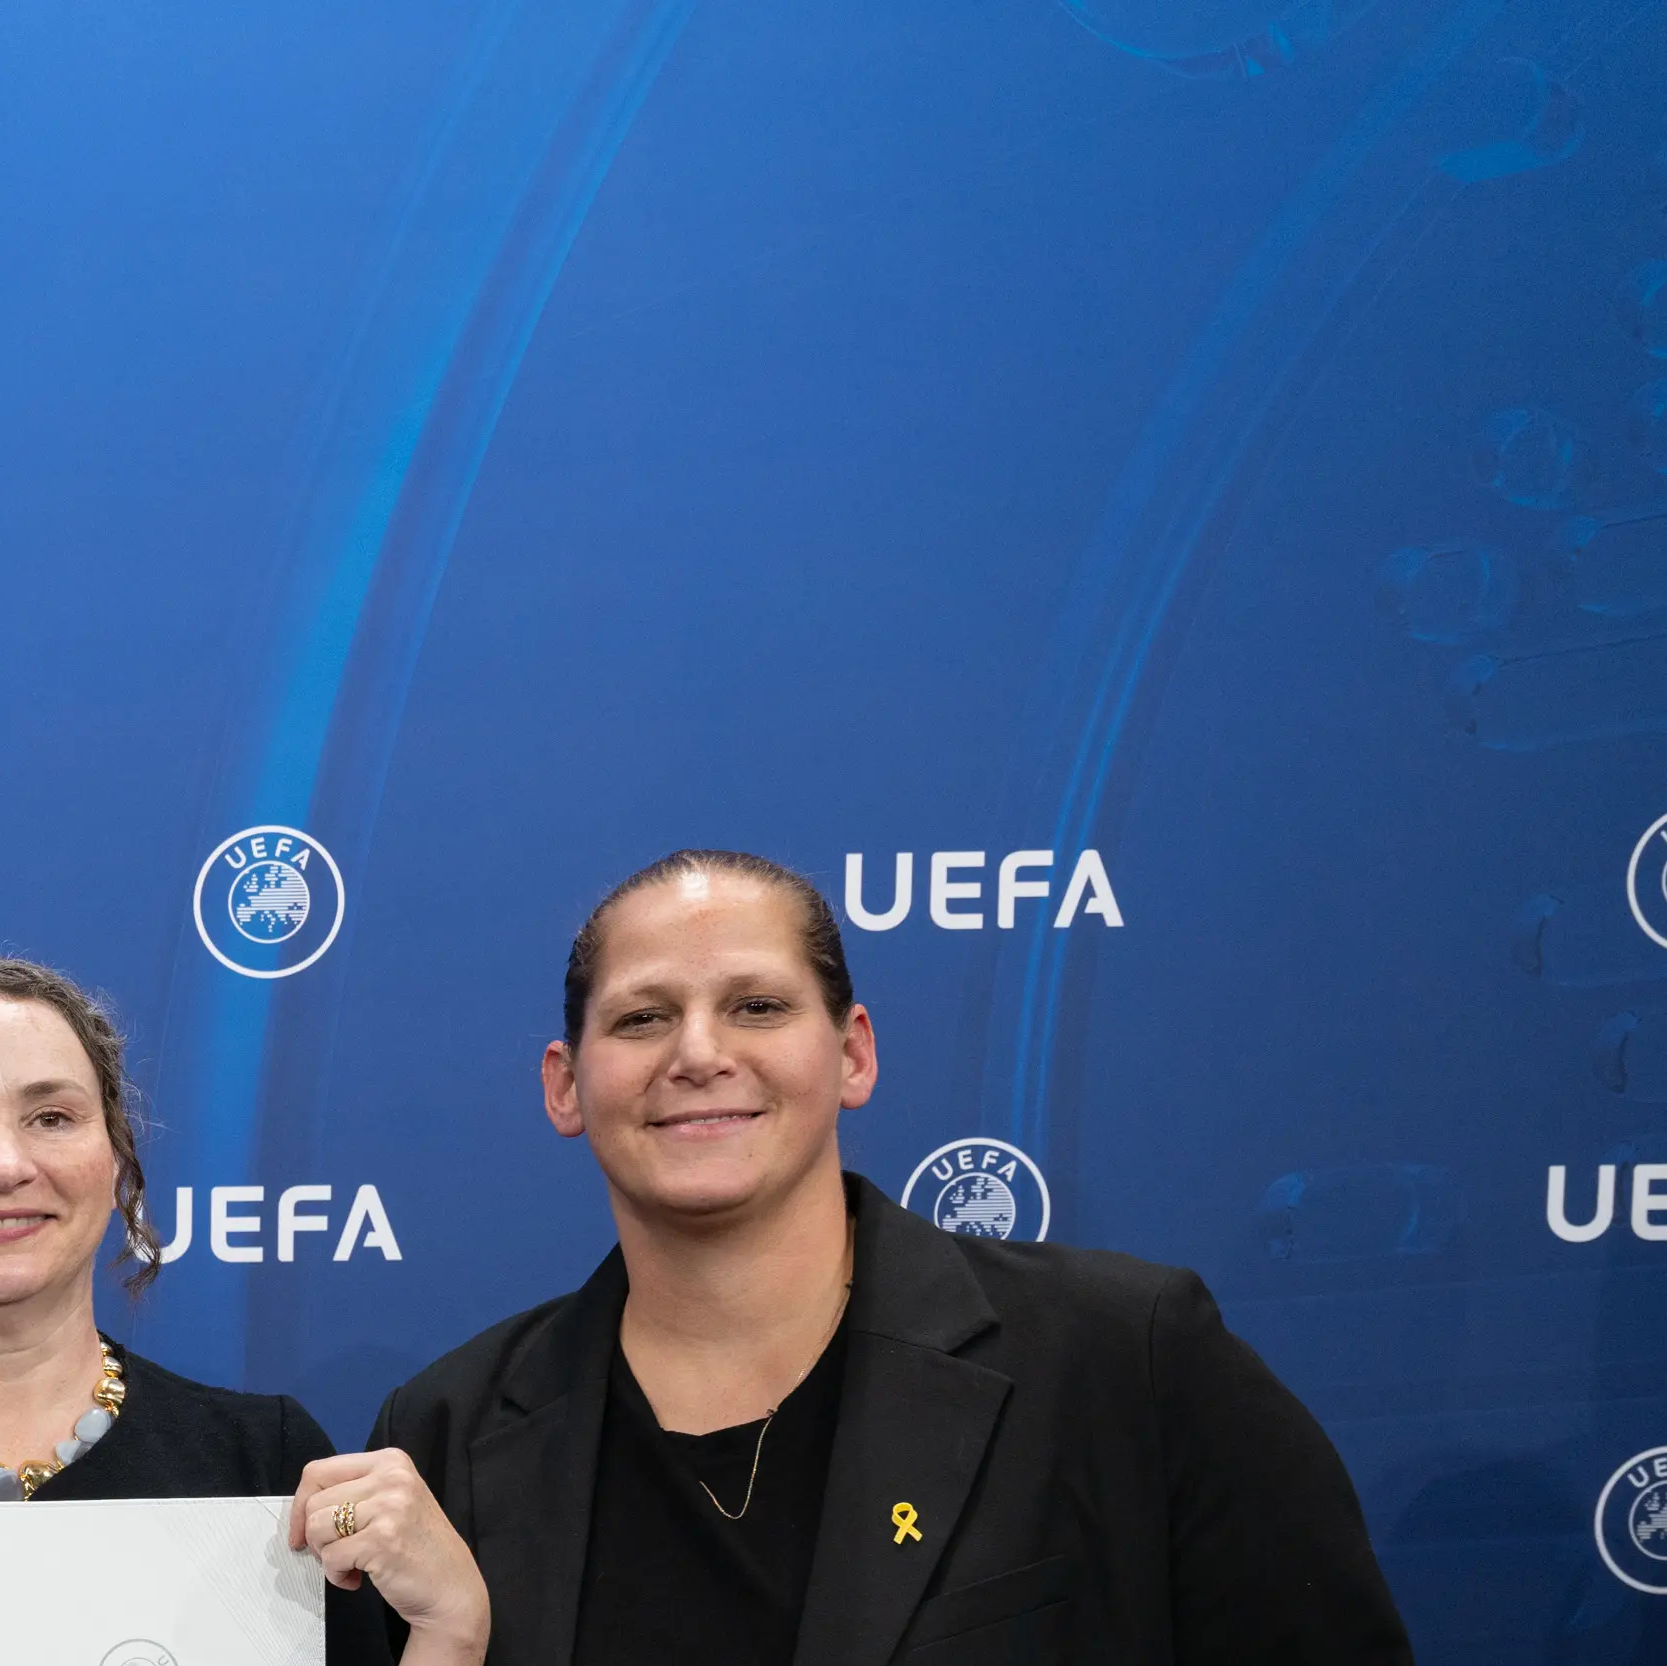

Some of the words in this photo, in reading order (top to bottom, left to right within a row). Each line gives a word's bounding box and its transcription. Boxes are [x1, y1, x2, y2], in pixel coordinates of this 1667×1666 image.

[224, 837, 310, 870] UEFA
[845, 849, 1124, 931] UEFA
[931, 1149, 1017, 1182] UEFA
[1547, 1163, 1667, 1243] UE
[1627, 1457, 1667, 1489] UE
